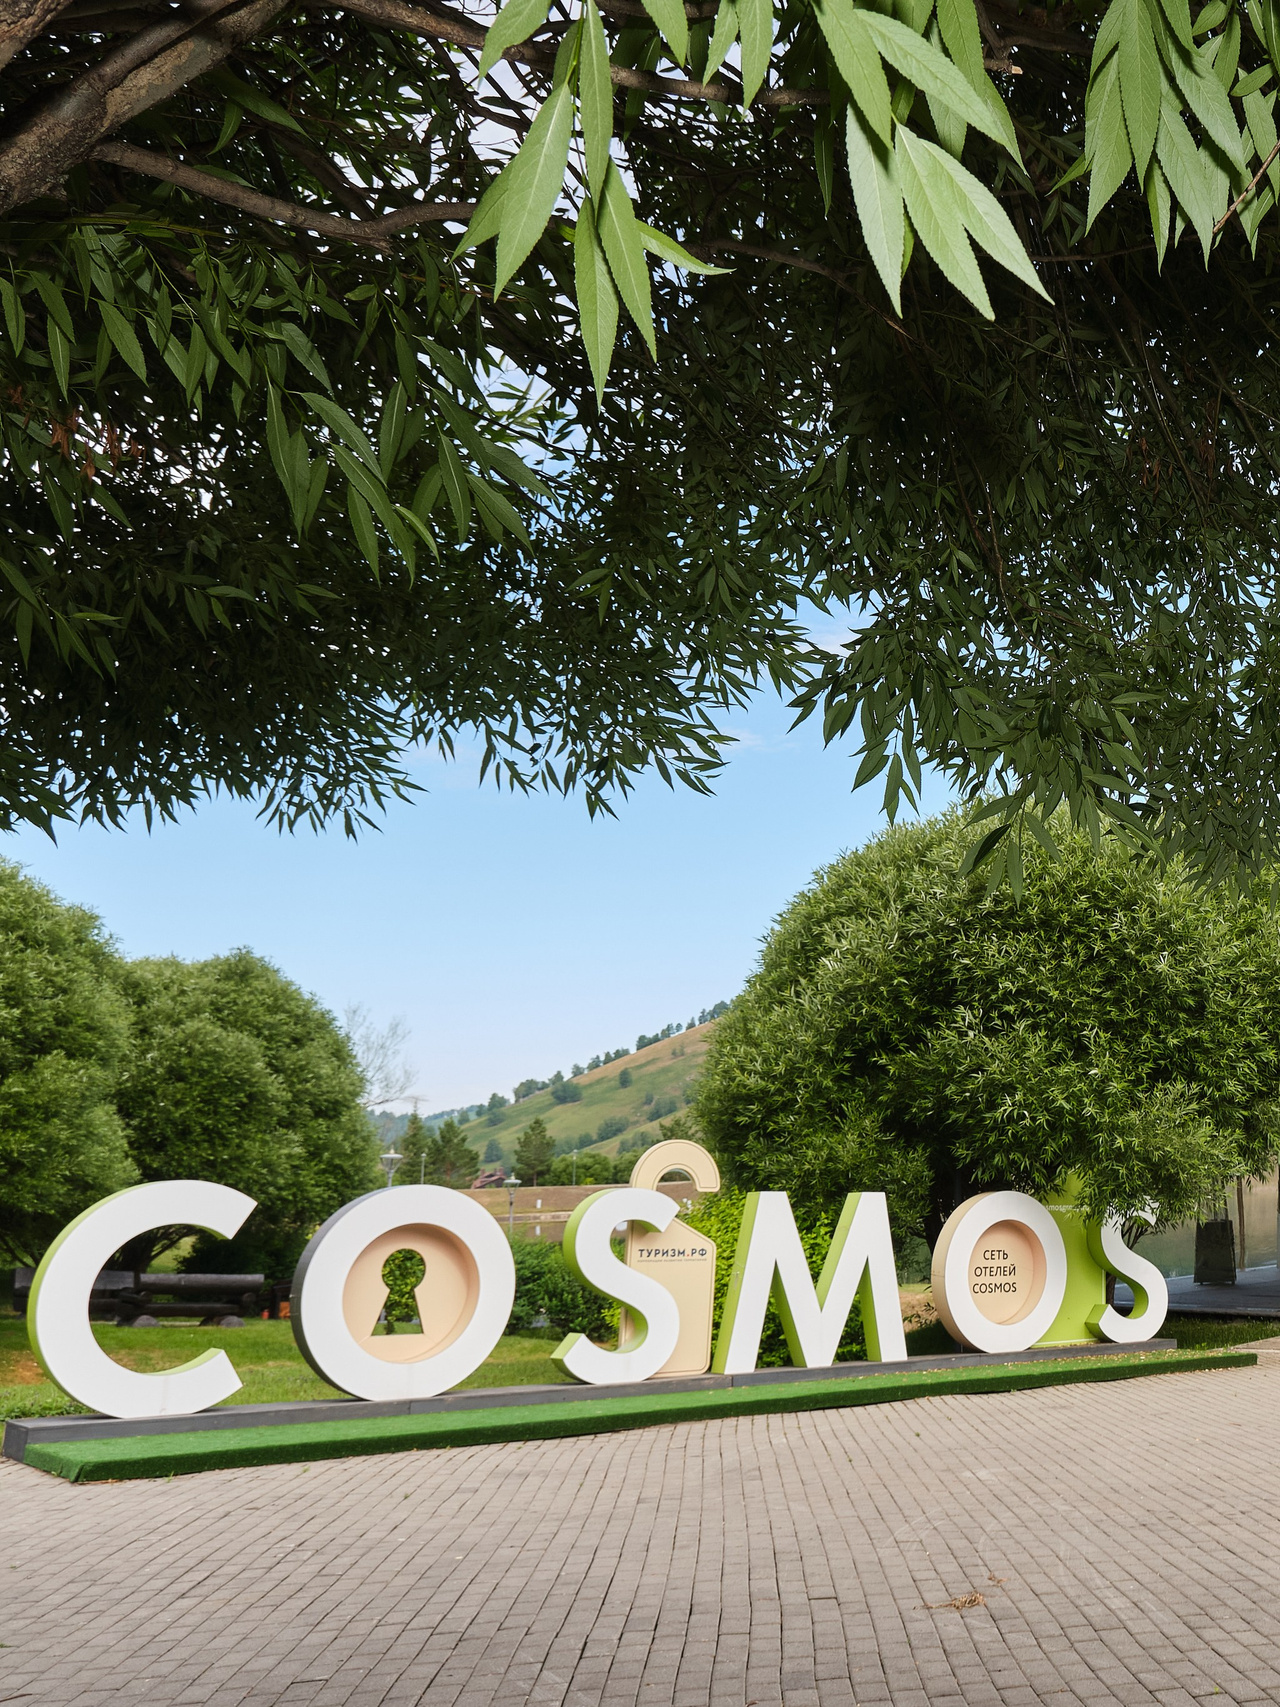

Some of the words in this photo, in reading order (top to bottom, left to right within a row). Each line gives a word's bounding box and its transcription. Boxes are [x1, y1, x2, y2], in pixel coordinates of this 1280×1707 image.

[638, 1248, 707, 1258] ТУРИЗМ.РФ
[983, 1249, 1009, 1261] СЕТЬ
[973, 1263, 1016, 1277] ОТЕЛЕЙ
[972, 1282, 1017, 1294] COSMOS
[29, 1179, 1169, 1418] COSMOS
